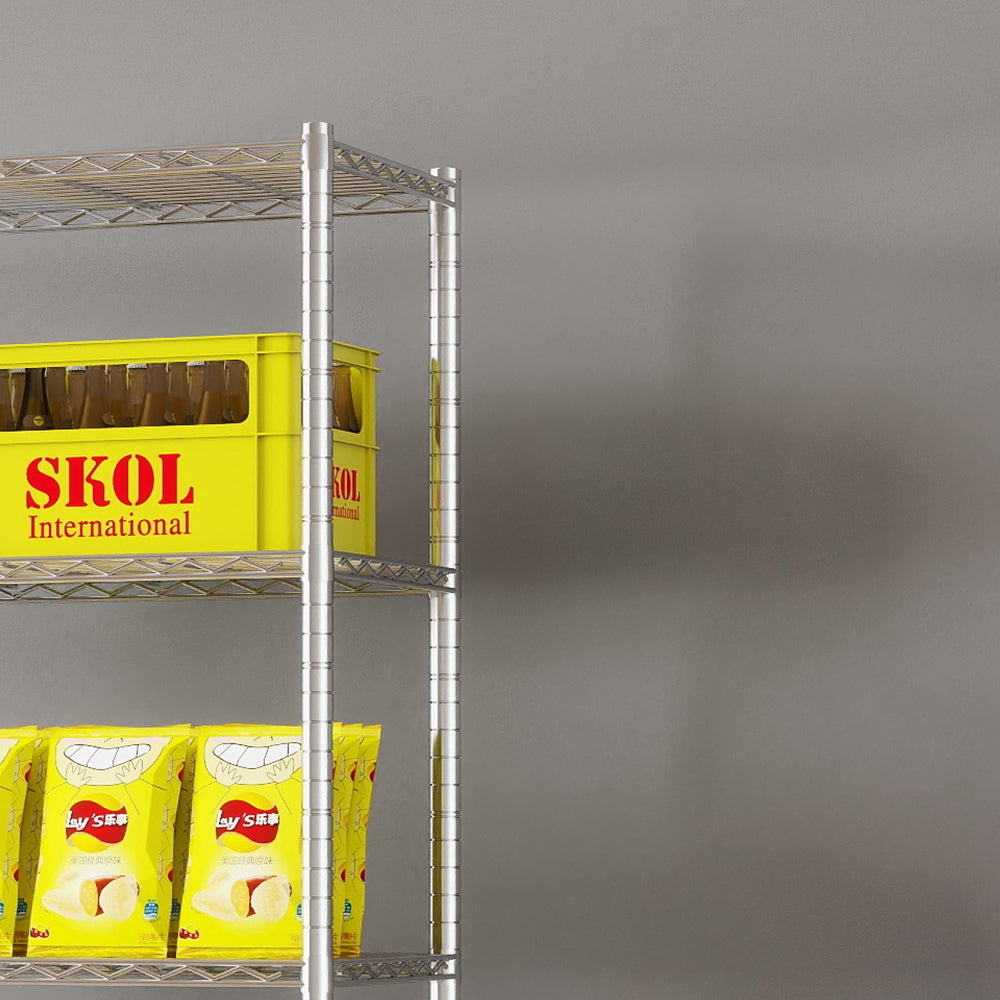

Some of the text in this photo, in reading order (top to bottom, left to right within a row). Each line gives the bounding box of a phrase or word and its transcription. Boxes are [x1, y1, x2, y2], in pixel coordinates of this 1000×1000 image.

[26, 453, 194, 509] SKOL
[332, 466, 361, 502] KOL
[28, 511, 191, 539] International
